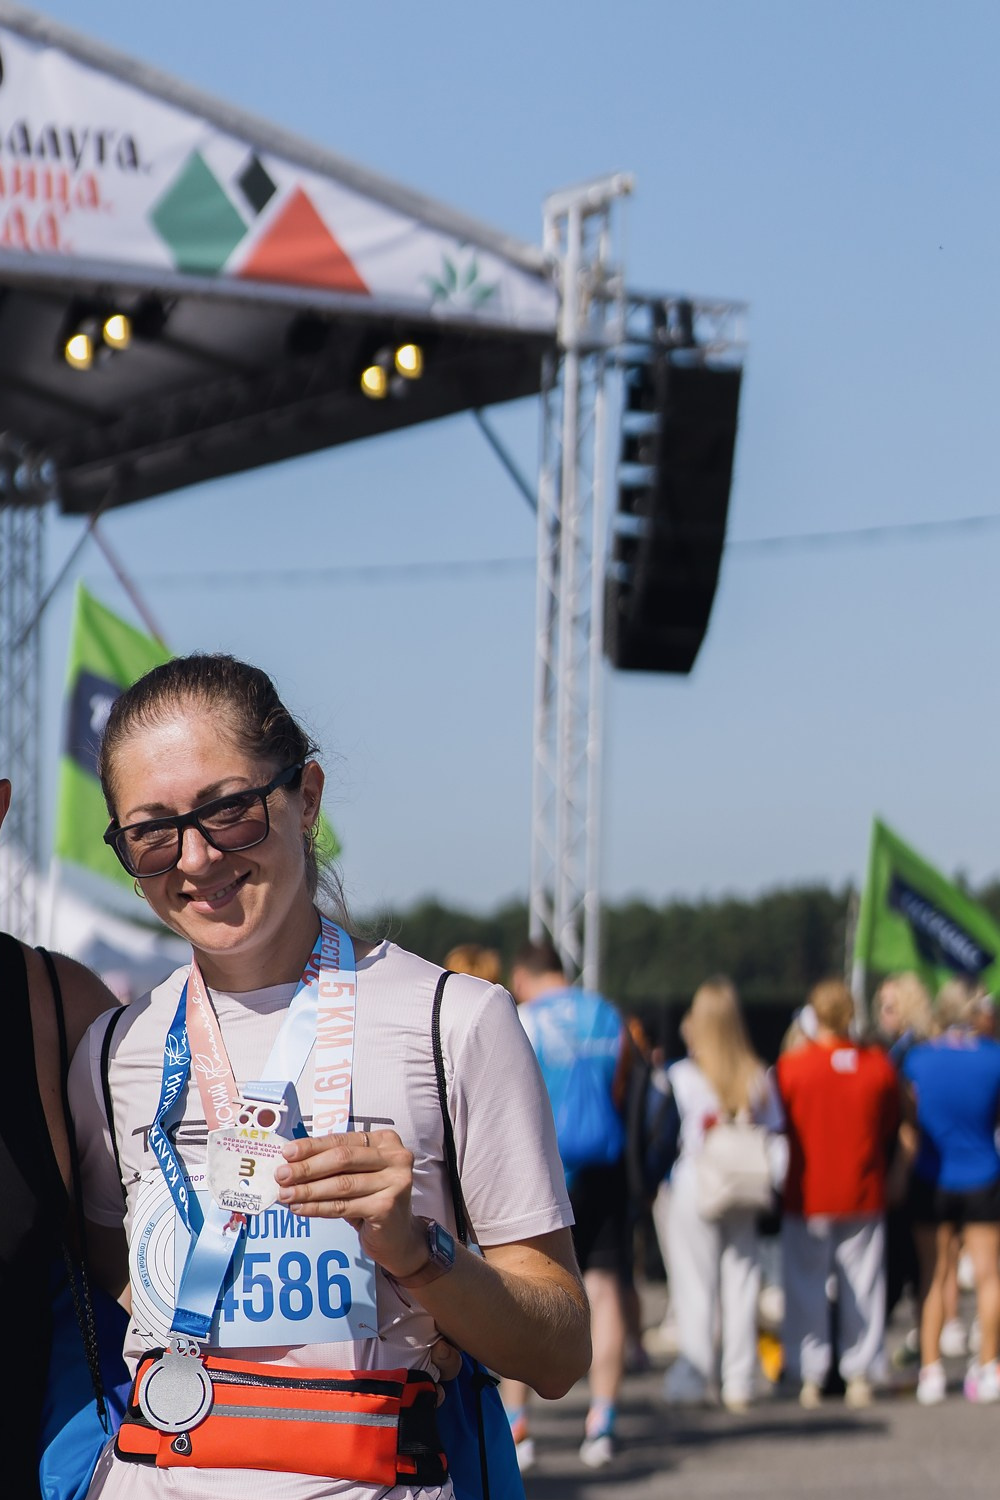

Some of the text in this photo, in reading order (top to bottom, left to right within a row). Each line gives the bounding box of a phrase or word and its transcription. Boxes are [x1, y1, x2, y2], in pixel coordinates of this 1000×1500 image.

[321, 921, 340, 974] МЕСТО
[319, 981, 355, 998] 5
[317, 1006, 354, 1050] КМ
[223, 1141, 259, 1151] открытый
[254, 1141, 281, 1149] выхода
[238, 1157, 256, 1177] 3
[222, 1199, 260, 1211] МАРАФОН
